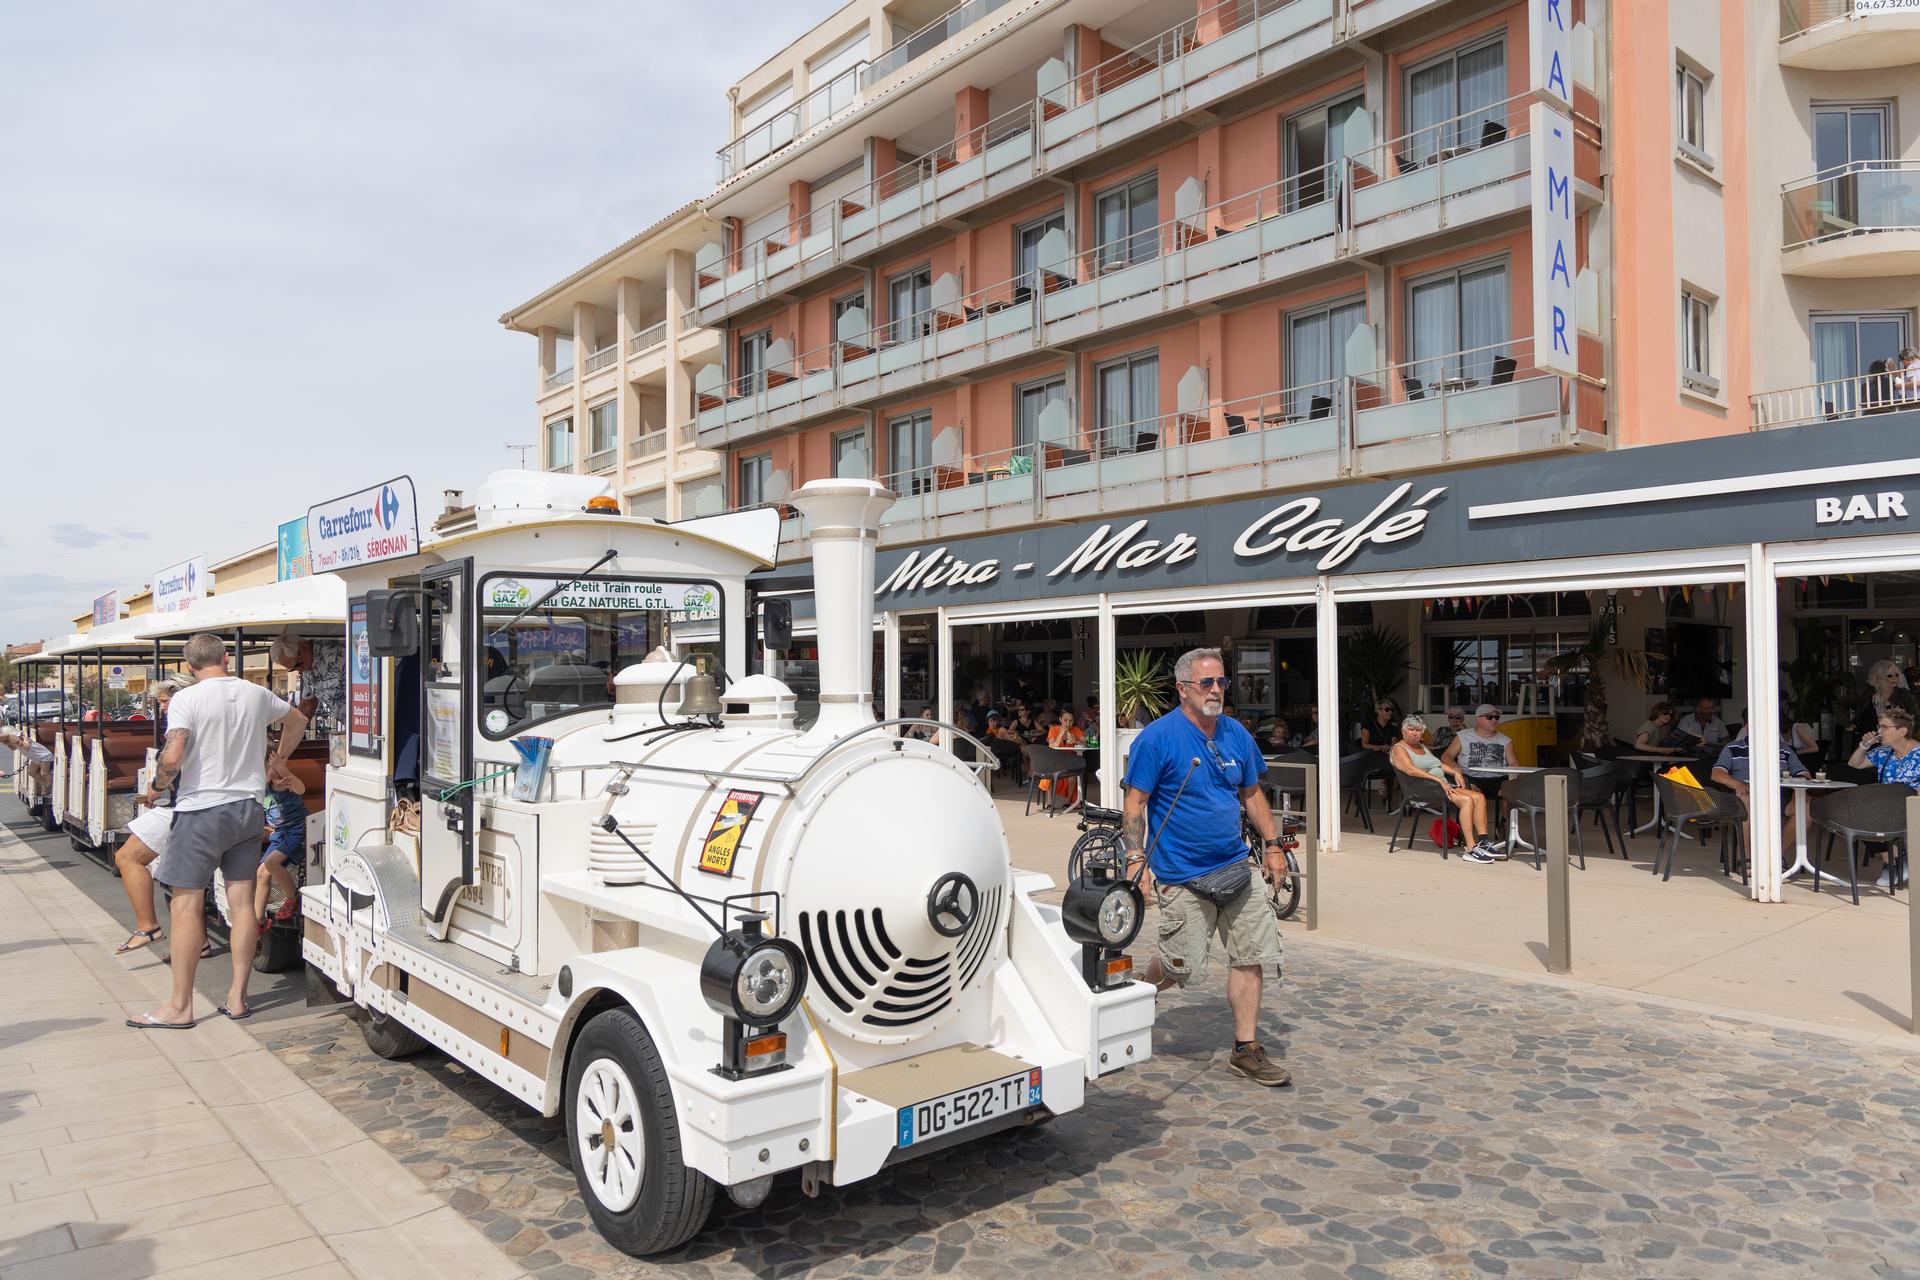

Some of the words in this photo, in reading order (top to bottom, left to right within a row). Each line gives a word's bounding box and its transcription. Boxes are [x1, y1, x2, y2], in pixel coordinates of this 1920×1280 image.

[1816, 491, 1910, 524] BAR
[319, 506, 374, 540] Carrefour
[874, 547, 1001, 595] Mira
[1045, 519, 1198, 577] Mar
[1233, 482, 1449, 571] Café
[367, 534, 408, 559] SÉRIGNAN
[573, 581, 600, 593] Petit
[603, 582, 631, 594] Train
[634, 583, 663, 594] roule
[493, 593, 517, 604] GAZ
[543, 598, 558, 607] au
[561, 596, 586, 608] GAZ
[589, 597, 643, 609] NATUREL
[645, 598, 674, 609] G.T.L.
[684, 598, 704, 607] GAZ
[670, 611, 687, 623] BAR
[729, 791, 760, 802] ATTENTION
[707, 844, 731, 857] ANGLES
[706, 854, 728, 867] MORTS
[479, 860, 504, 887] IVER
[903, 1130, 910, 1140] F
[918, 1076, 1026, 1138] DG-522-TT
[1029, 1087, 1041, 1102] 34
